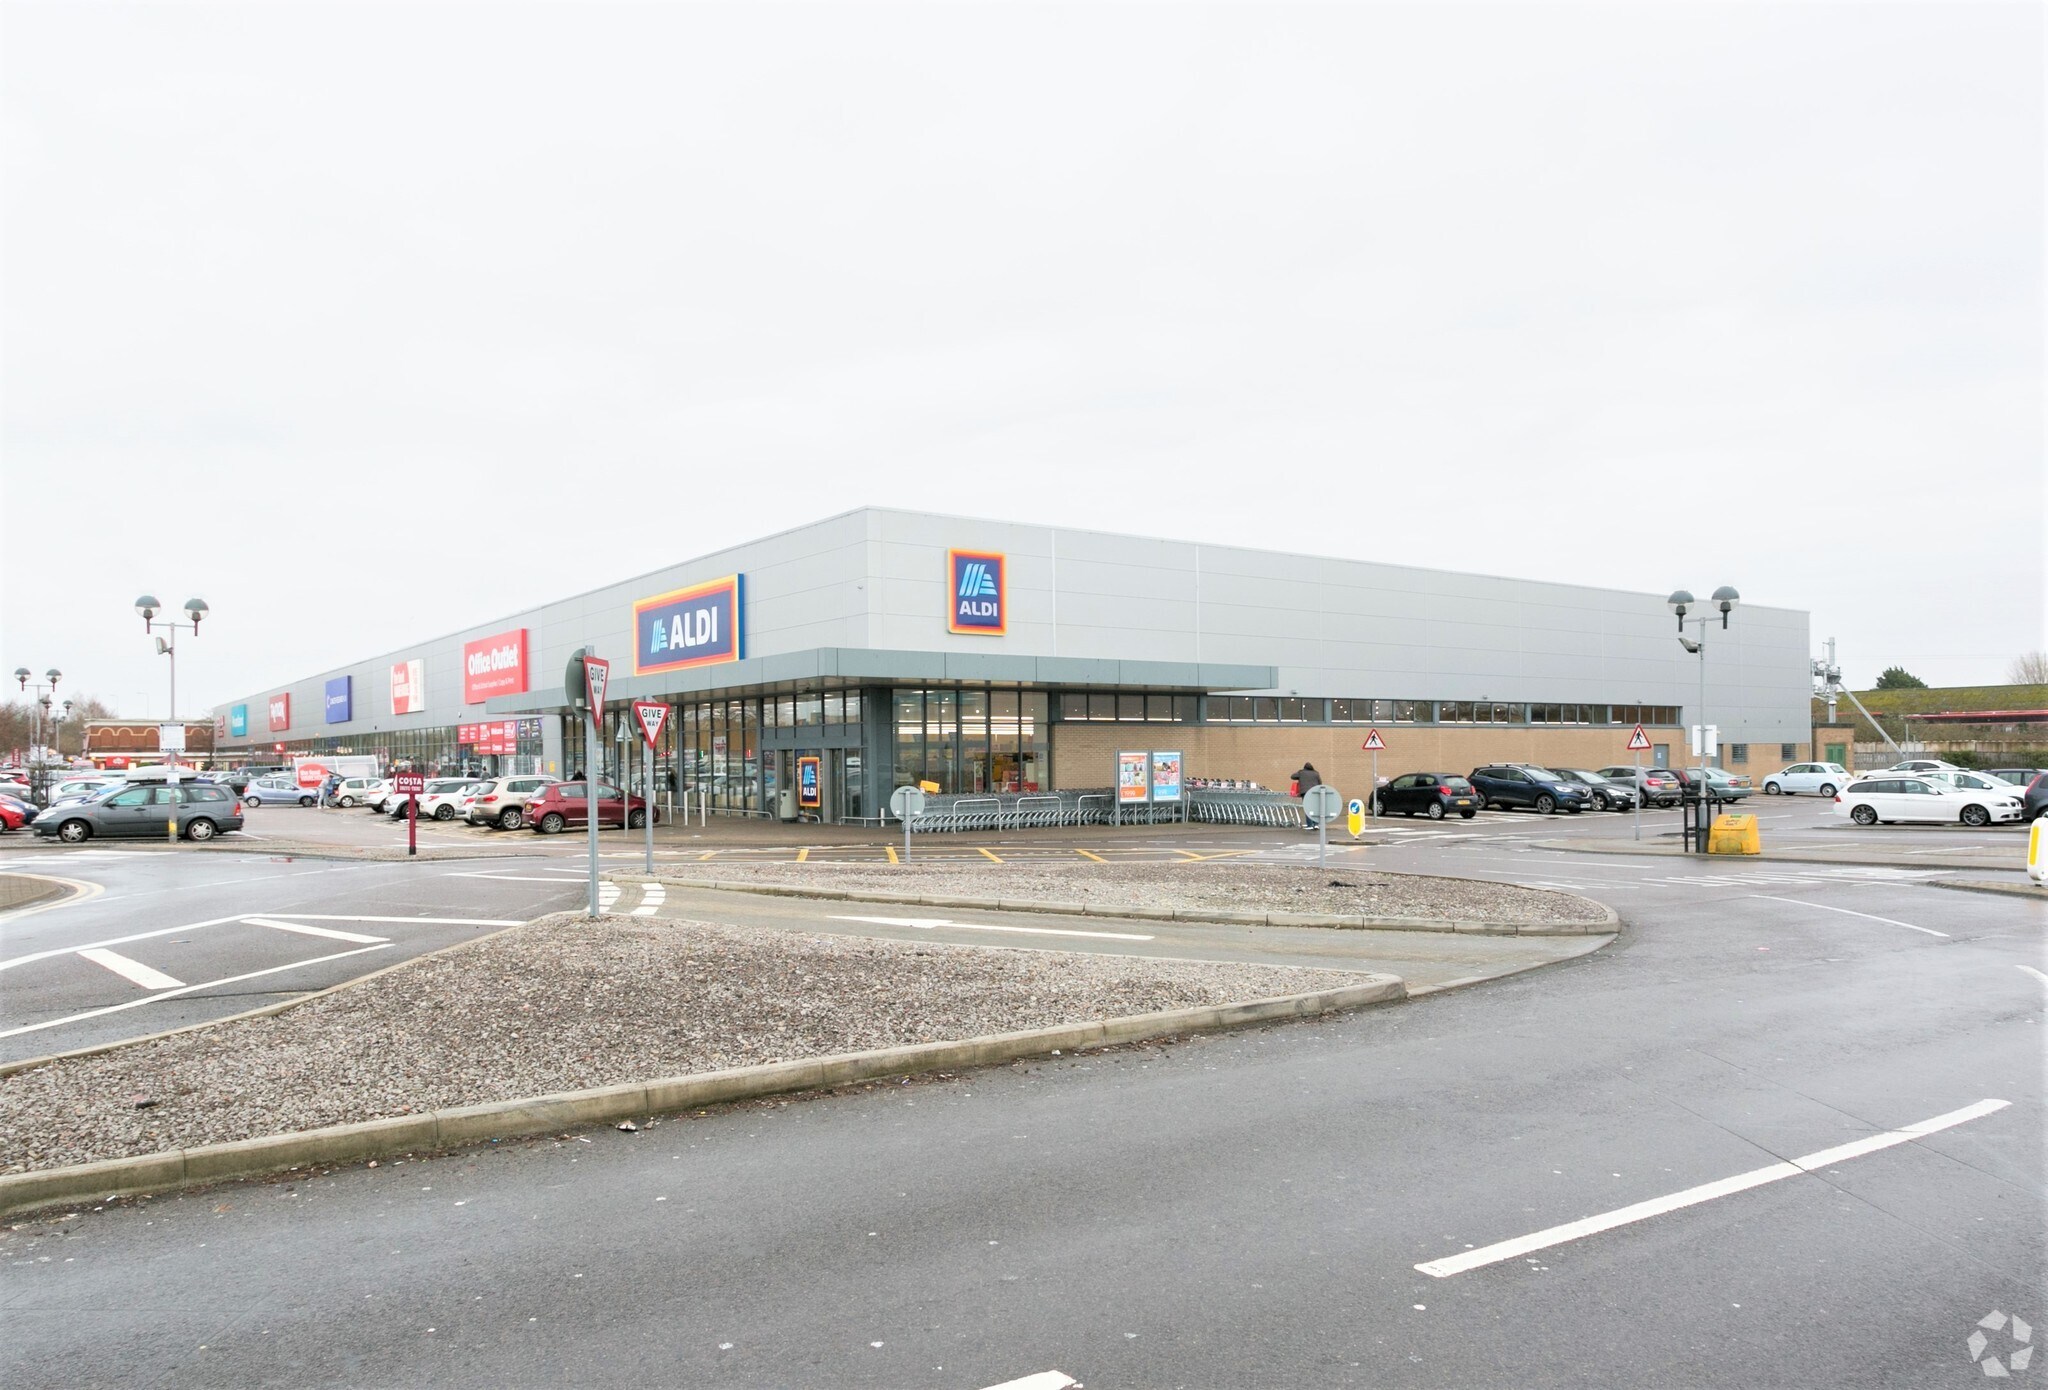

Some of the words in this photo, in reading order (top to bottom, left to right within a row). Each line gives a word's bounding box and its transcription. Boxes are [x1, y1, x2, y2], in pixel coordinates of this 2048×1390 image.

[959, 600, 998, 617] ALDI
[669, 605, 718, 650] ALDI
[468, 651, 491, 676] Office
[491, 643, 518, 671] Outlet
[589, 666, 604, 682] GIVE
[593, 685, 603, 694] WAY
[641, 708, 662, 719] GIVE
[398, 776, 422, 786] COSTA
[802, 787, 817, 797] ALDI
